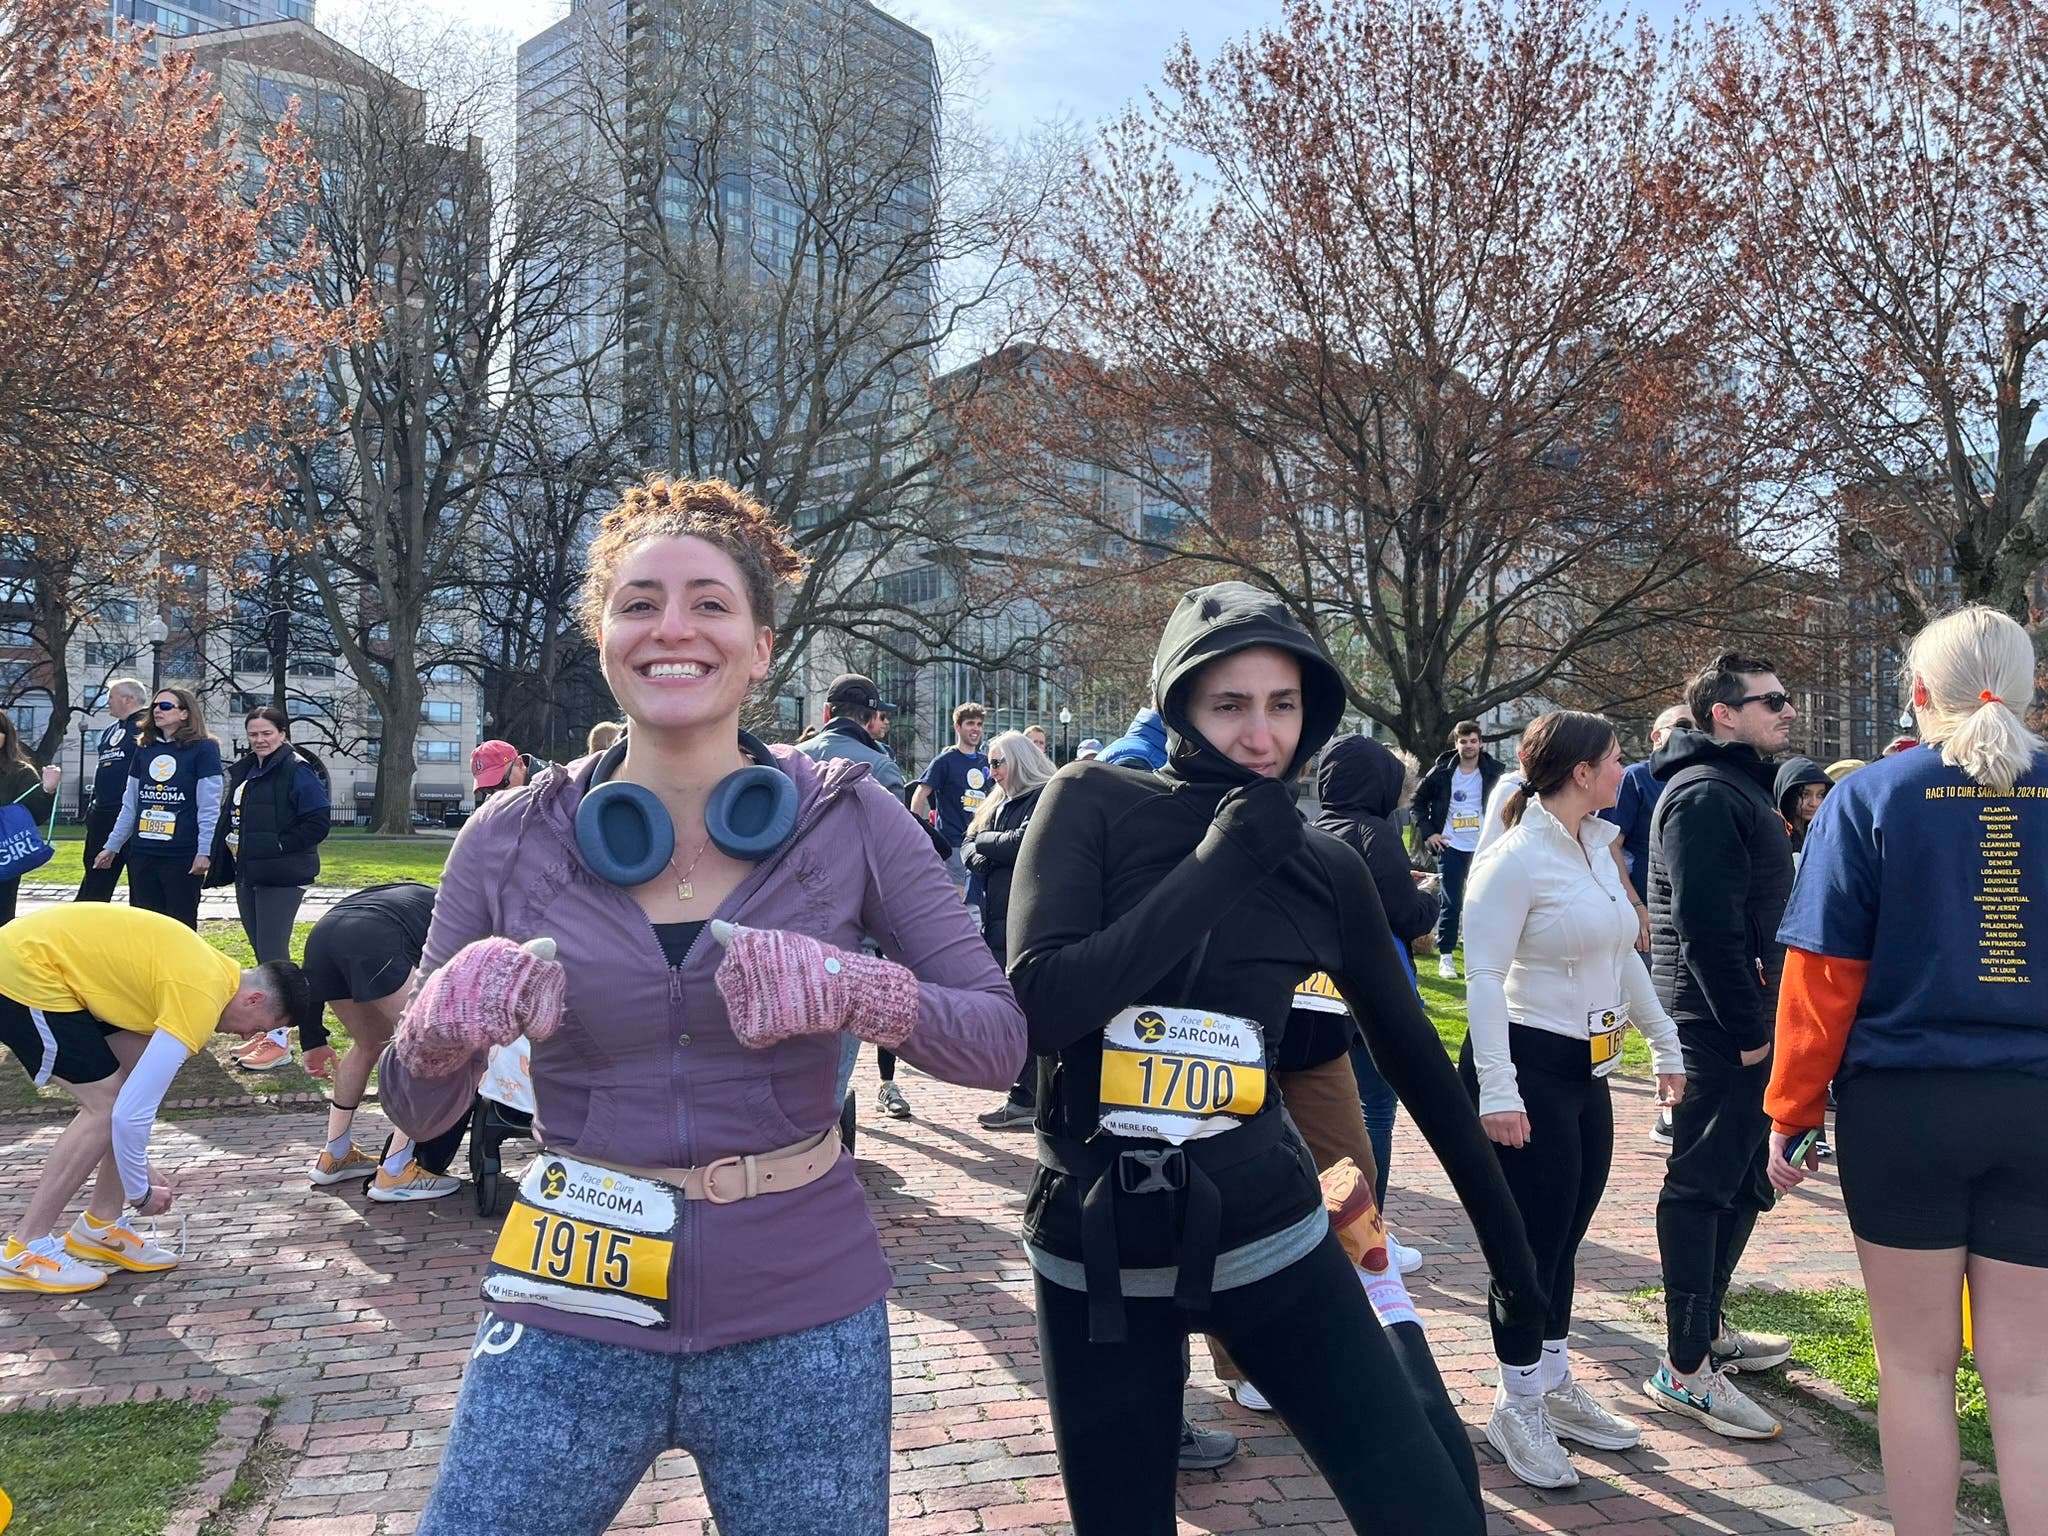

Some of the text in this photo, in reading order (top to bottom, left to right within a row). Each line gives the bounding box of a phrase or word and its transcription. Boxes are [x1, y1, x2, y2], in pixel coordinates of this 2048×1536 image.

[140, 790, 186, 801] SARCOMA
[1925, 787, 1945, 800] RACE
[1946, 786, 1956, 798] TO
[1957, 786, 1976, 798] CURE
[2016, 787, 2036, 798] 2024
[145, 821, 166, 832] 1895
[0, 830, 32, 848] HLETA
[1180, 1015, 1231, 1031] Race Cure
[1168, 1026, 1240, 1049] SARCOMA
[1138, 1055, 1234, 1111] 1700
[1105, 1121, 1159, 1133] I'M HERE FOR
[580, 1171, 635, 1194] Race Cure
[566, 1183, 643, 1216] SARCOMA
[531, 1214, 632, 1289] 1915
[501, 1288, 526, 1299] HERE
[529, 1293, 549, 1302] FOR
[1682, 1314, 1691, 1337] PRO
